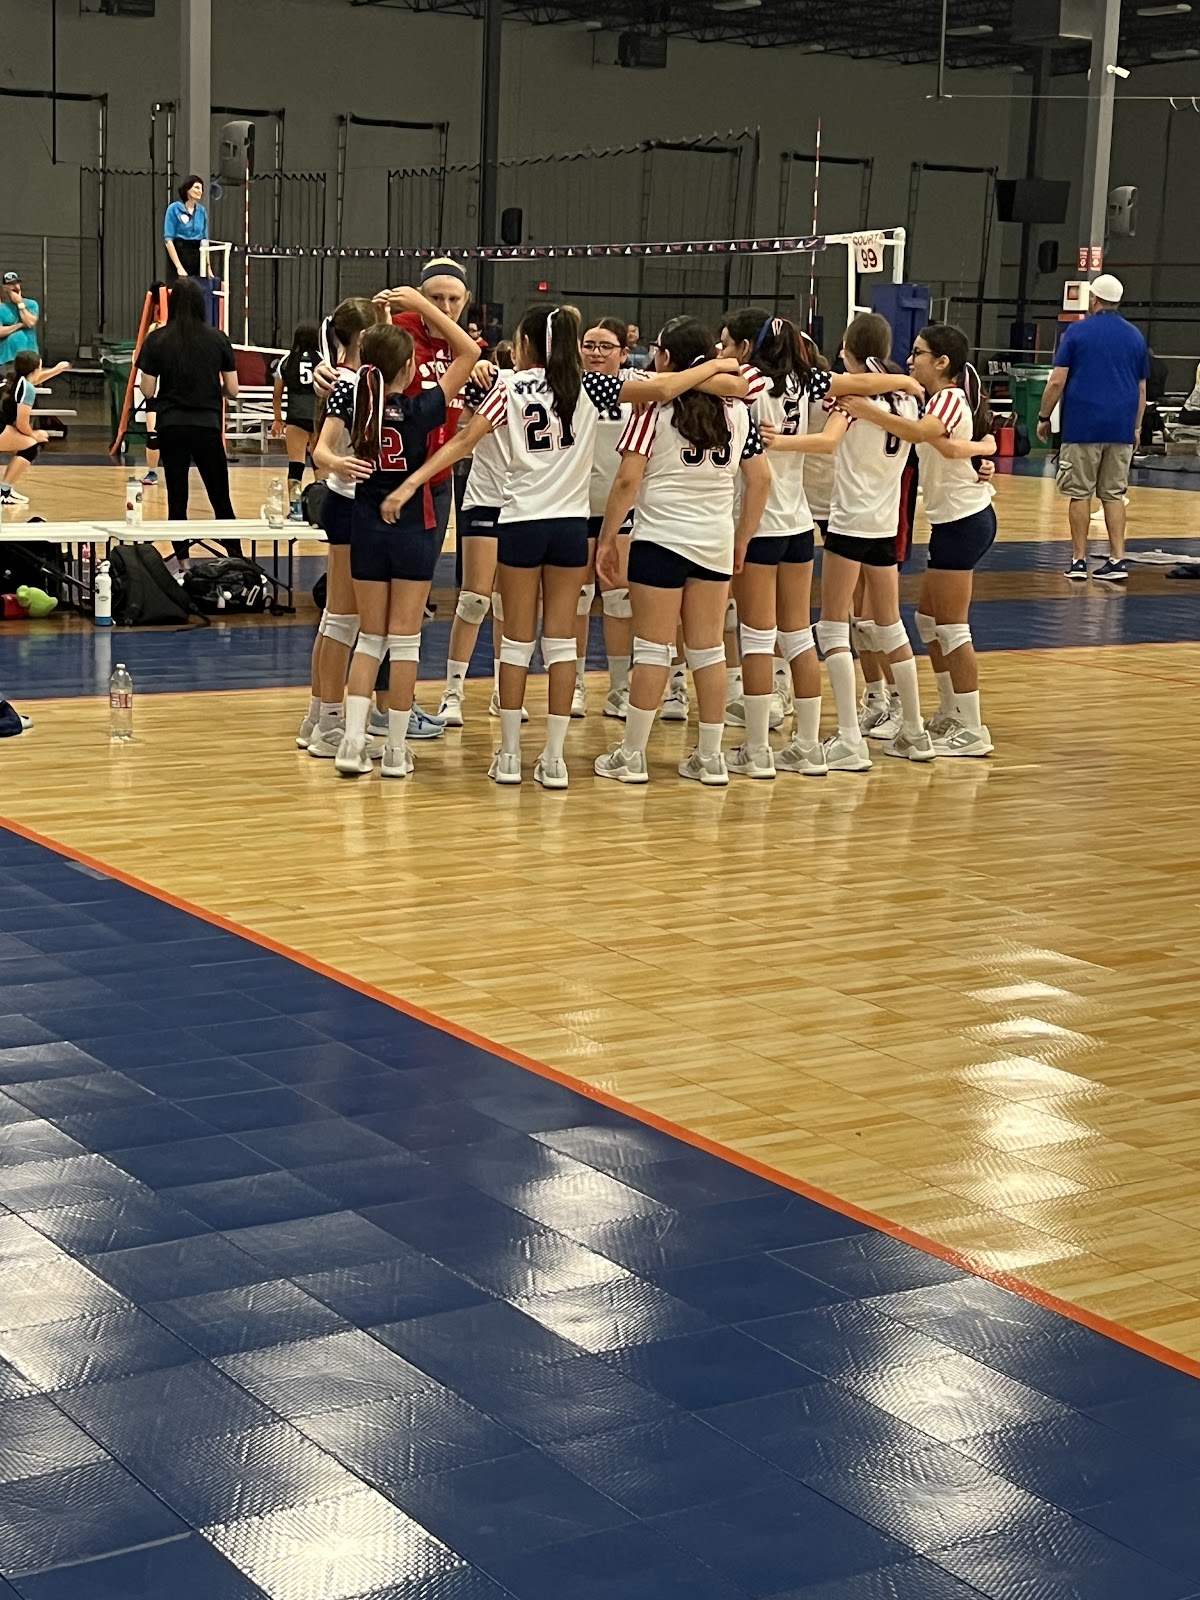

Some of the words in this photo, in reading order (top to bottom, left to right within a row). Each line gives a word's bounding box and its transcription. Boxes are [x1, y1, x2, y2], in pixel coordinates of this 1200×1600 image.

[852, 233, 879, 246] COURT
[861, 248, 878, 269] 99
[299, 361, 314, 385] 5
[522, 402, 576, 453] 21
